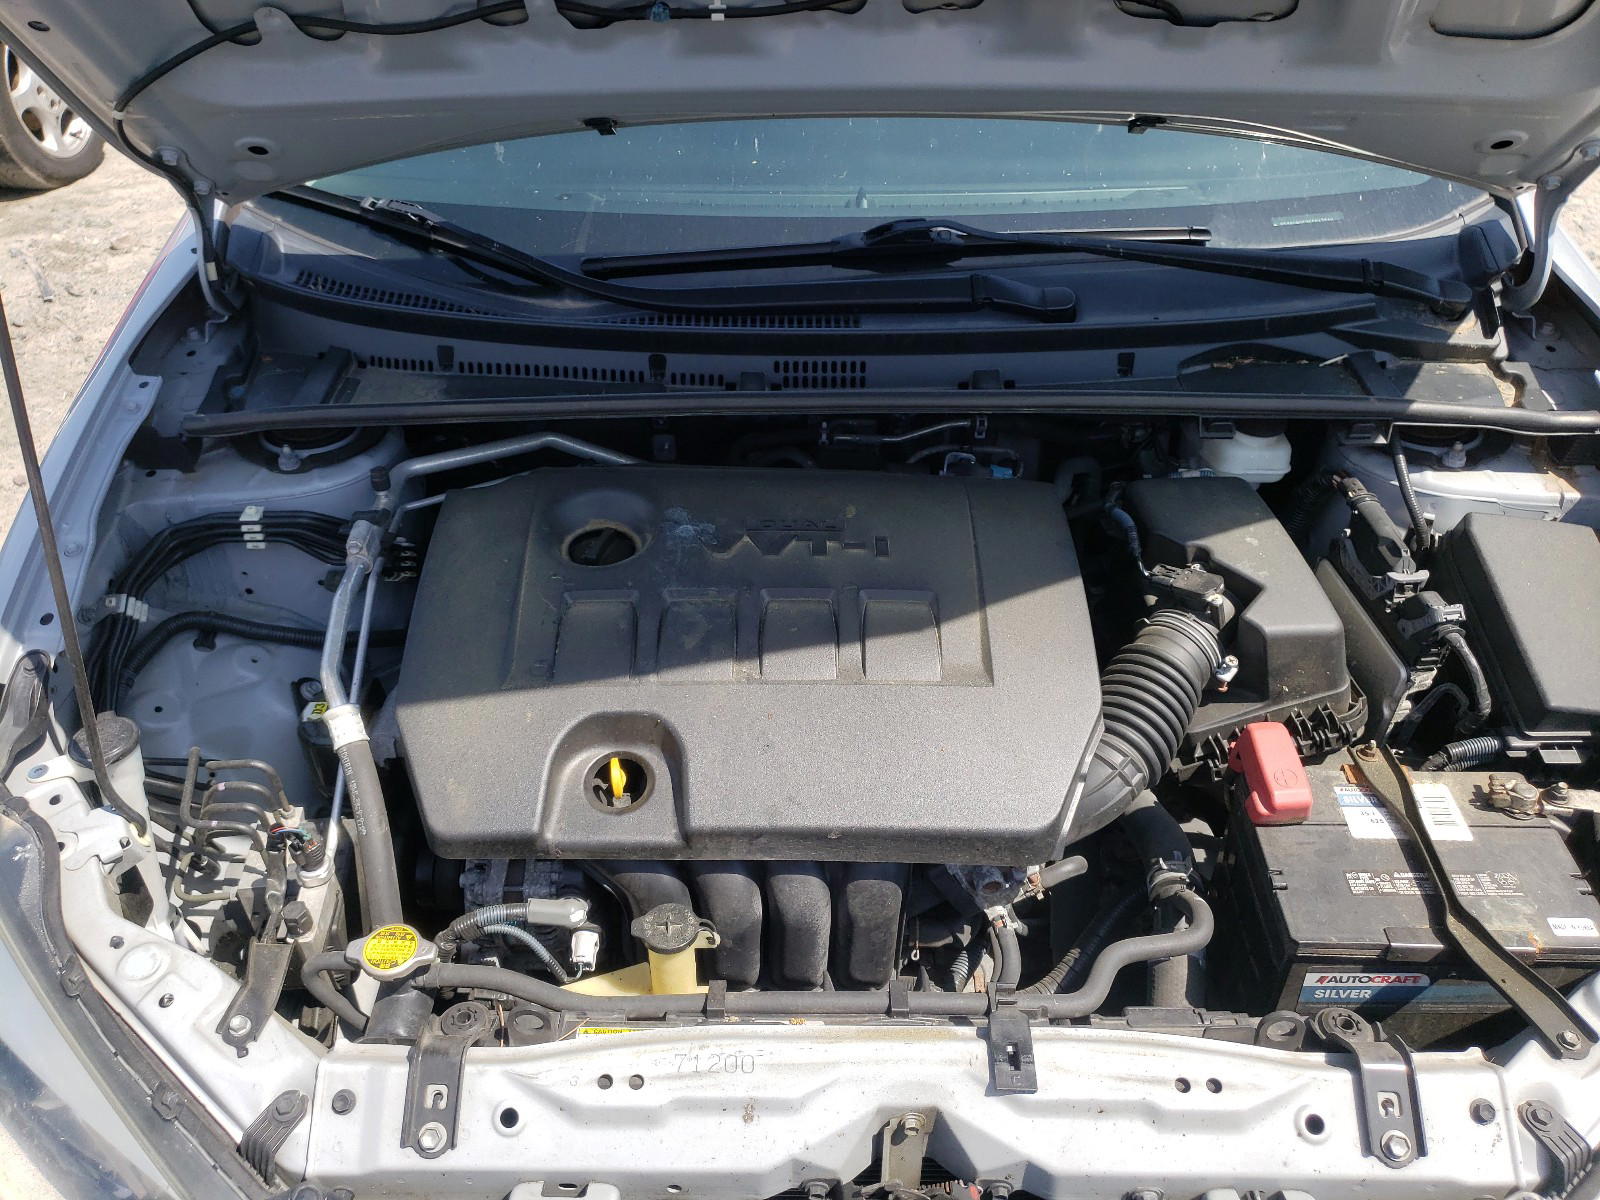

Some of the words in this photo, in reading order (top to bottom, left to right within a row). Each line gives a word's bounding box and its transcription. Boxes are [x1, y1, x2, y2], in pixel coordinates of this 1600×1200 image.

[1326, 975, 1422, 984] AUTOCRAFT
[1314, 989, 1372, 999] SILVER
[674, 1053, 755, 1074] 71200
